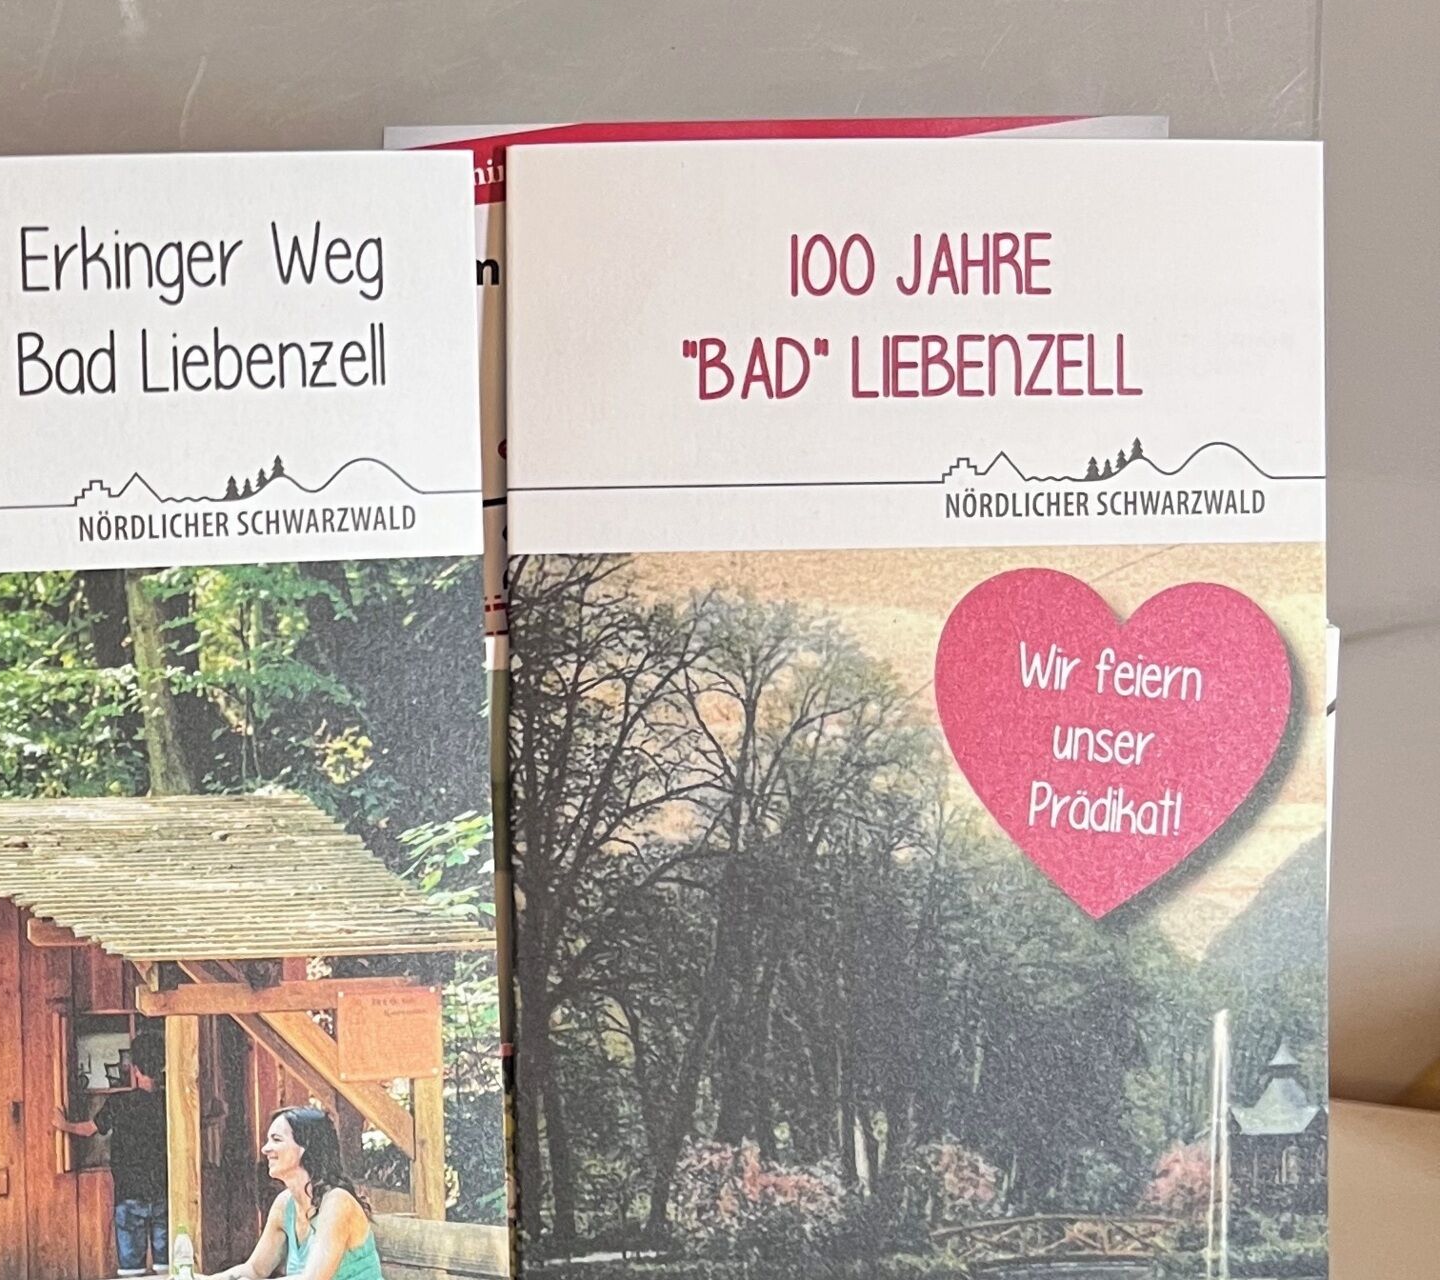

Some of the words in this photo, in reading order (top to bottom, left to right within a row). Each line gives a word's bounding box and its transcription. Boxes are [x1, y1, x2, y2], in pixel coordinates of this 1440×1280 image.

[20, 224, 243, 306] Erkinger
[271, 221, 384, 301] Weg
[791, 232, 875, 297] 100
[896, 232, 1052, 296] JAHRE
[17, 329, 117, 396] Bad
[141, 322, 387, 393] Liebenzell
[78, 510, 229, 542] NÖRDLICHER
[237, 504, 417, 536] SCHWARZWALD
[945, 488, 1089, 519] NÖRDLICHER
[1097, 489, 1266, 517] SCHWARZWALD
[1019, 640, 1081, 691] Wir
[1094, 647, 1203, 702] feiern
[1051, 725, 1155, 766] unser
[1028, 780, 1183, 836] Prädikat!
